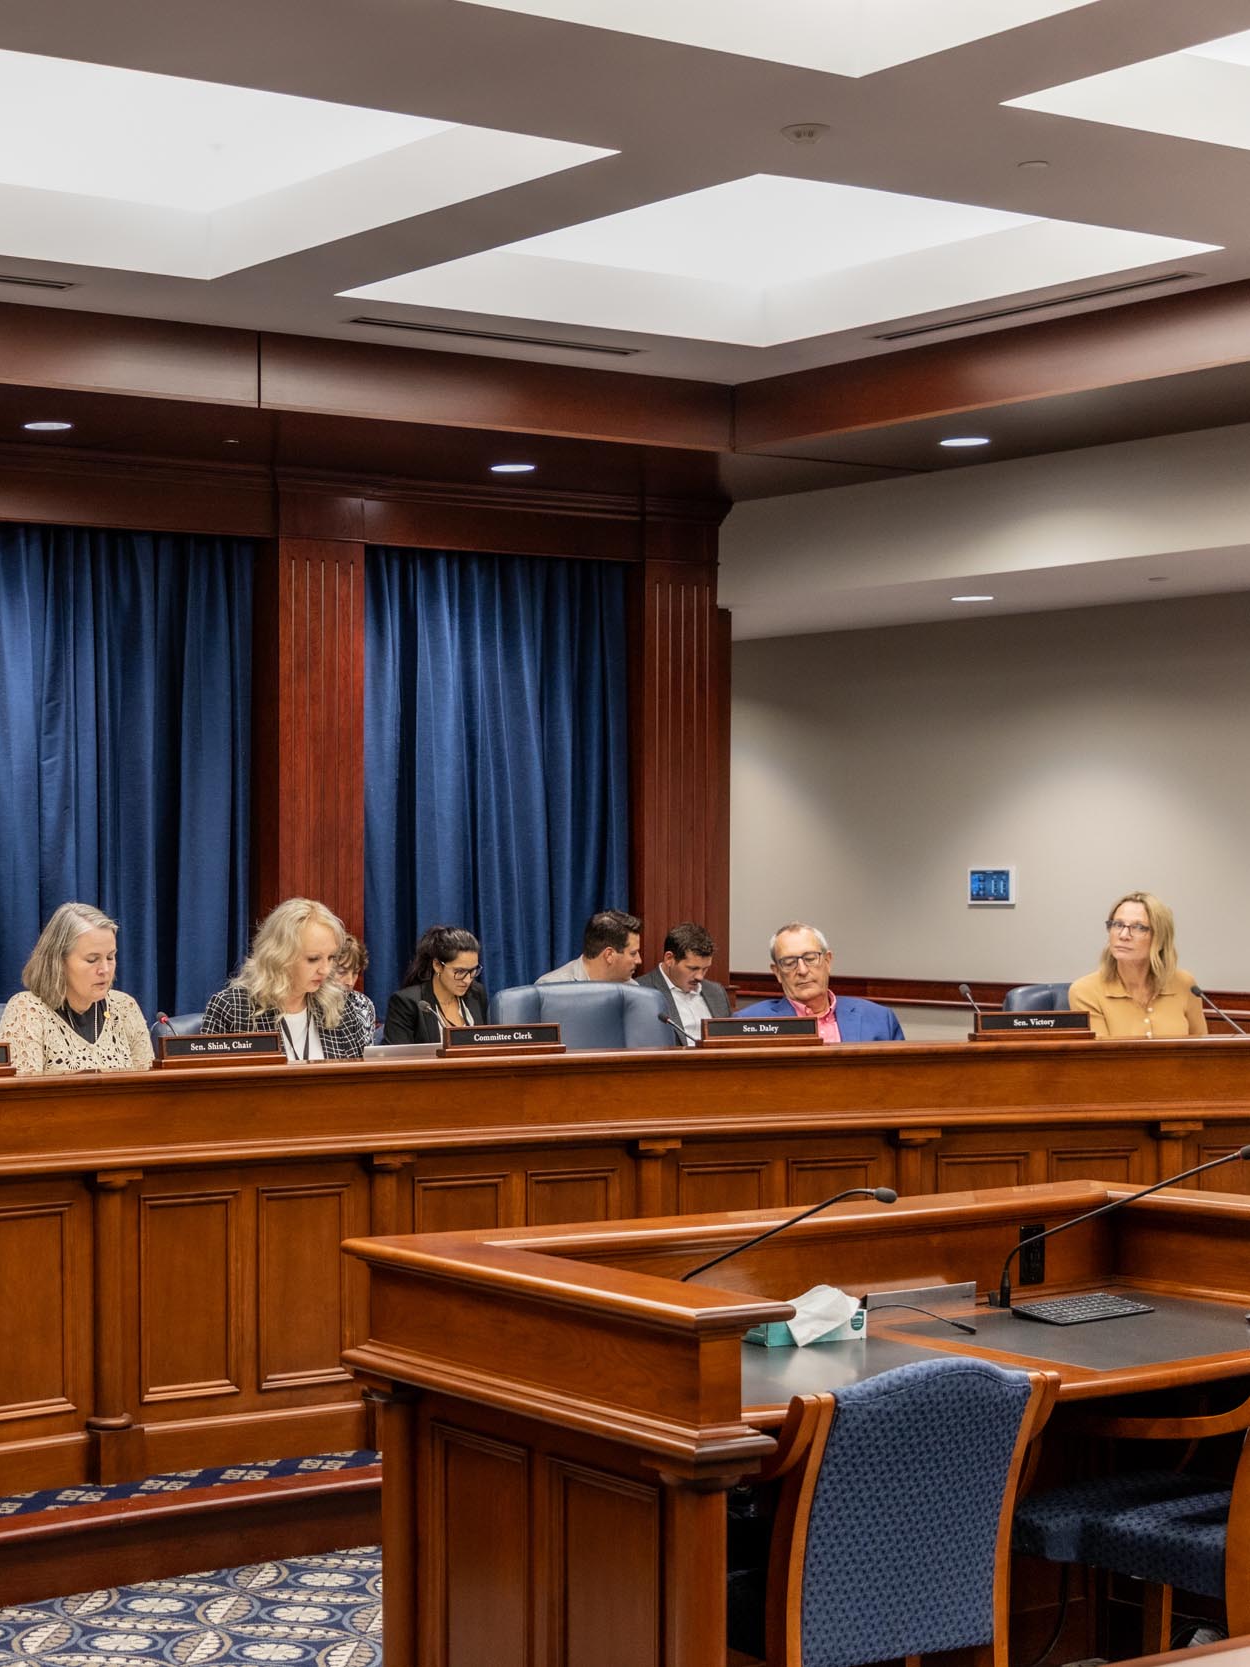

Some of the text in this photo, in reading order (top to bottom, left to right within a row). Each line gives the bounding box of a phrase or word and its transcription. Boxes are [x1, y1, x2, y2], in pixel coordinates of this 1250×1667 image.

[1013, 1018, 1055, 1028] Sen. Victory
[742, 1024, 779, 1034] Sen. Daley
[473, 1031, 533, 1042] Committee Clerk
[190, 1040, 253, 1051] Sen. Shink, Chair
